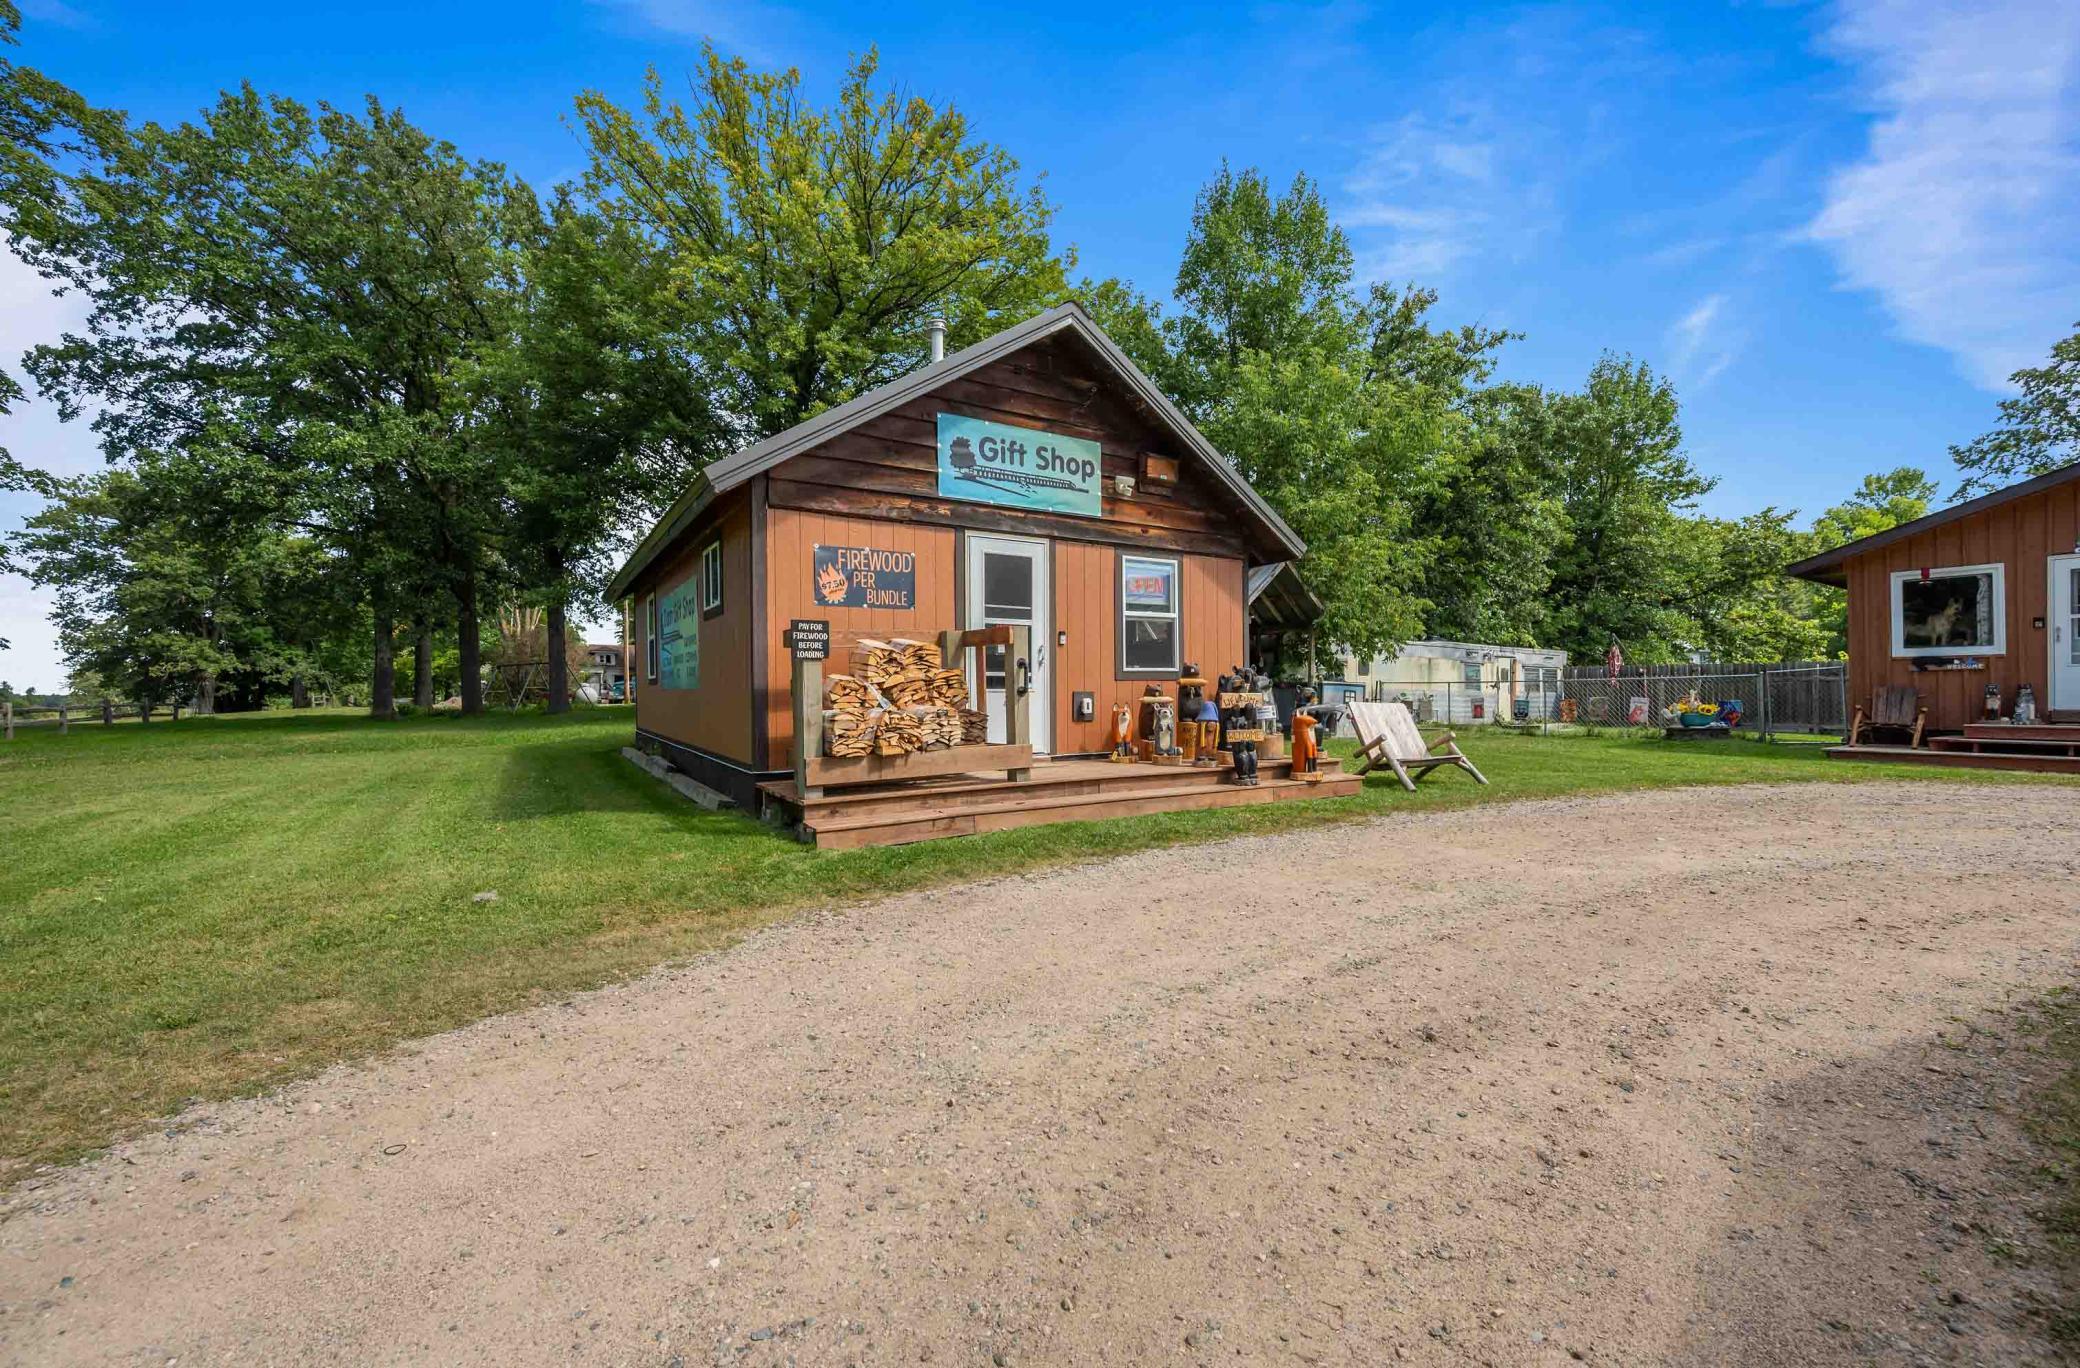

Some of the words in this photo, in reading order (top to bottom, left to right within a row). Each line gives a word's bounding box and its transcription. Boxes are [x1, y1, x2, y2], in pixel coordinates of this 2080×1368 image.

[978, 436, 1027, 467] Gift
[1035, 445, 1095, 483] Shop
[837, 549, 912, 573] FIREWOOD
[853, 571, 876, 588] PER
[866, 588, 908, 606] BUNDLE
[798, 622, 810, 630] PAY
[810, 623, 823, 631] FOR
[793, 631, 828, 640] FIREWOOD
[798, 641, 824, 649] BEFORE
[796, 650, 825, 659] LOADING
